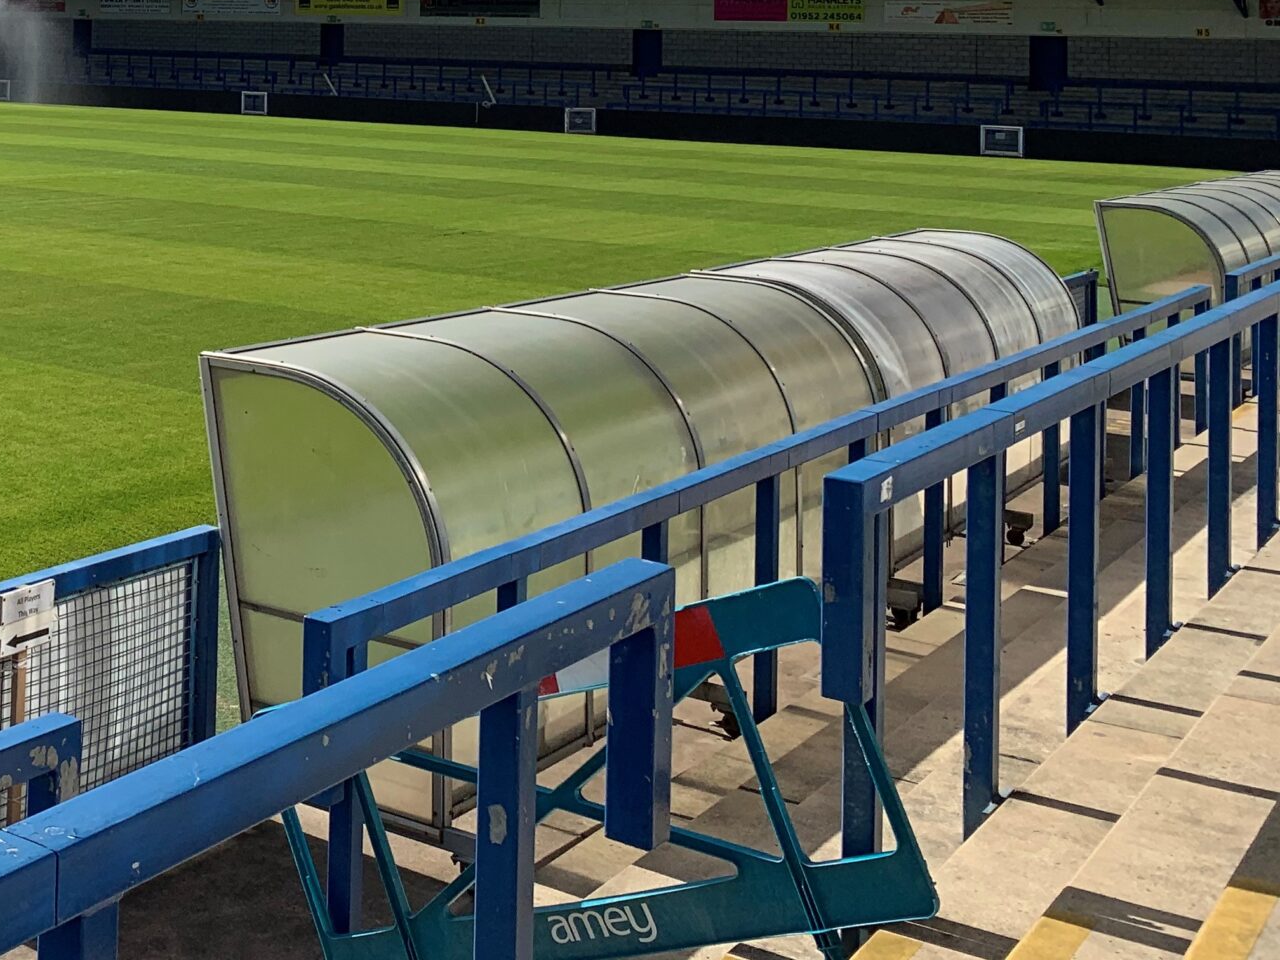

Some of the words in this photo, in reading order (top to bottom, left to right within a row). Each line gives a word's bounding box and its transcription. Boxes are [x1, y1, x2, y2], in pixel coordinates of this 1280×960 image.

[790, 12, 820, 20] 01952
[822, 12, 862, 20] 245064
[24, 594, 41, 603] Players
[548, 901, 658, 944] amey
